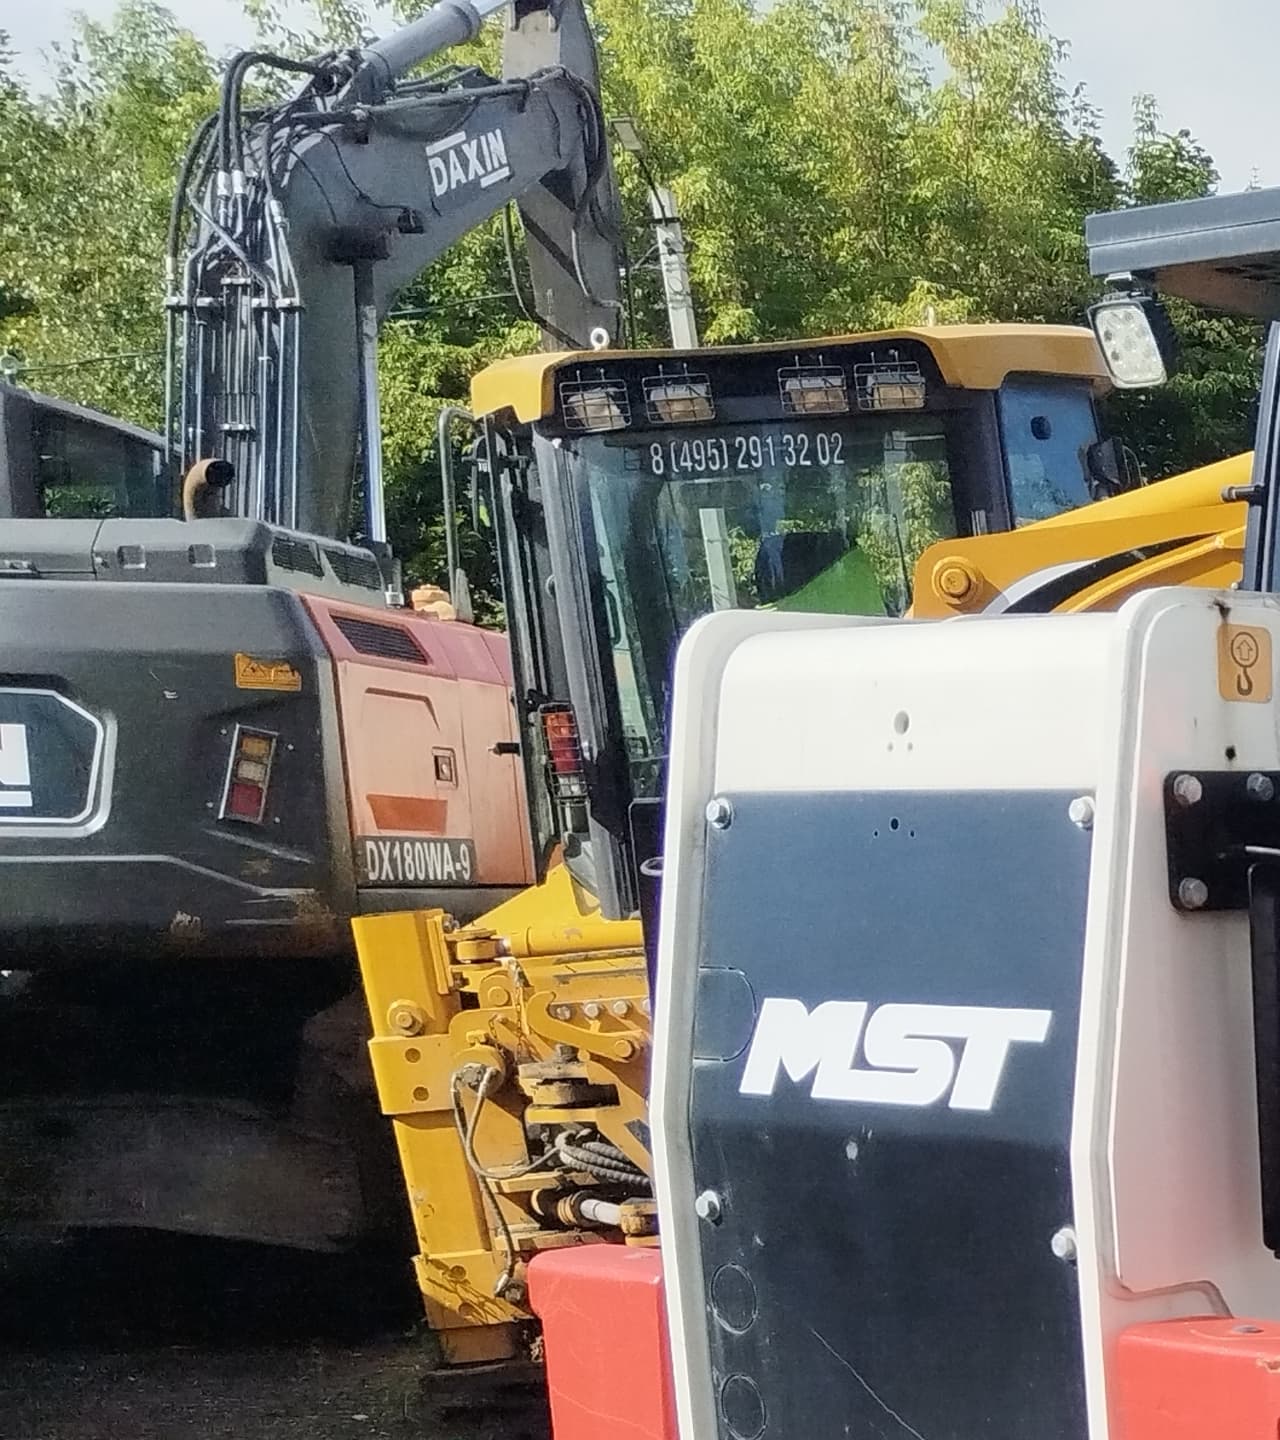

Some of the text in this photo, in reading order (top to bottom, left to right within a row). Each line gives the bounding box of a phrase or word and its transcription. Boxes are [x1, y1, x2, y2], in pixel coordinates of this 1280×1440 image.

[427, 128, 508, 197] DAXIN
[650, 432, 845, 475] 8 (495) 291 32 02
[365, 840, 471, 881] DX180WA-9
[739, 997, 1052, 1111] MST
